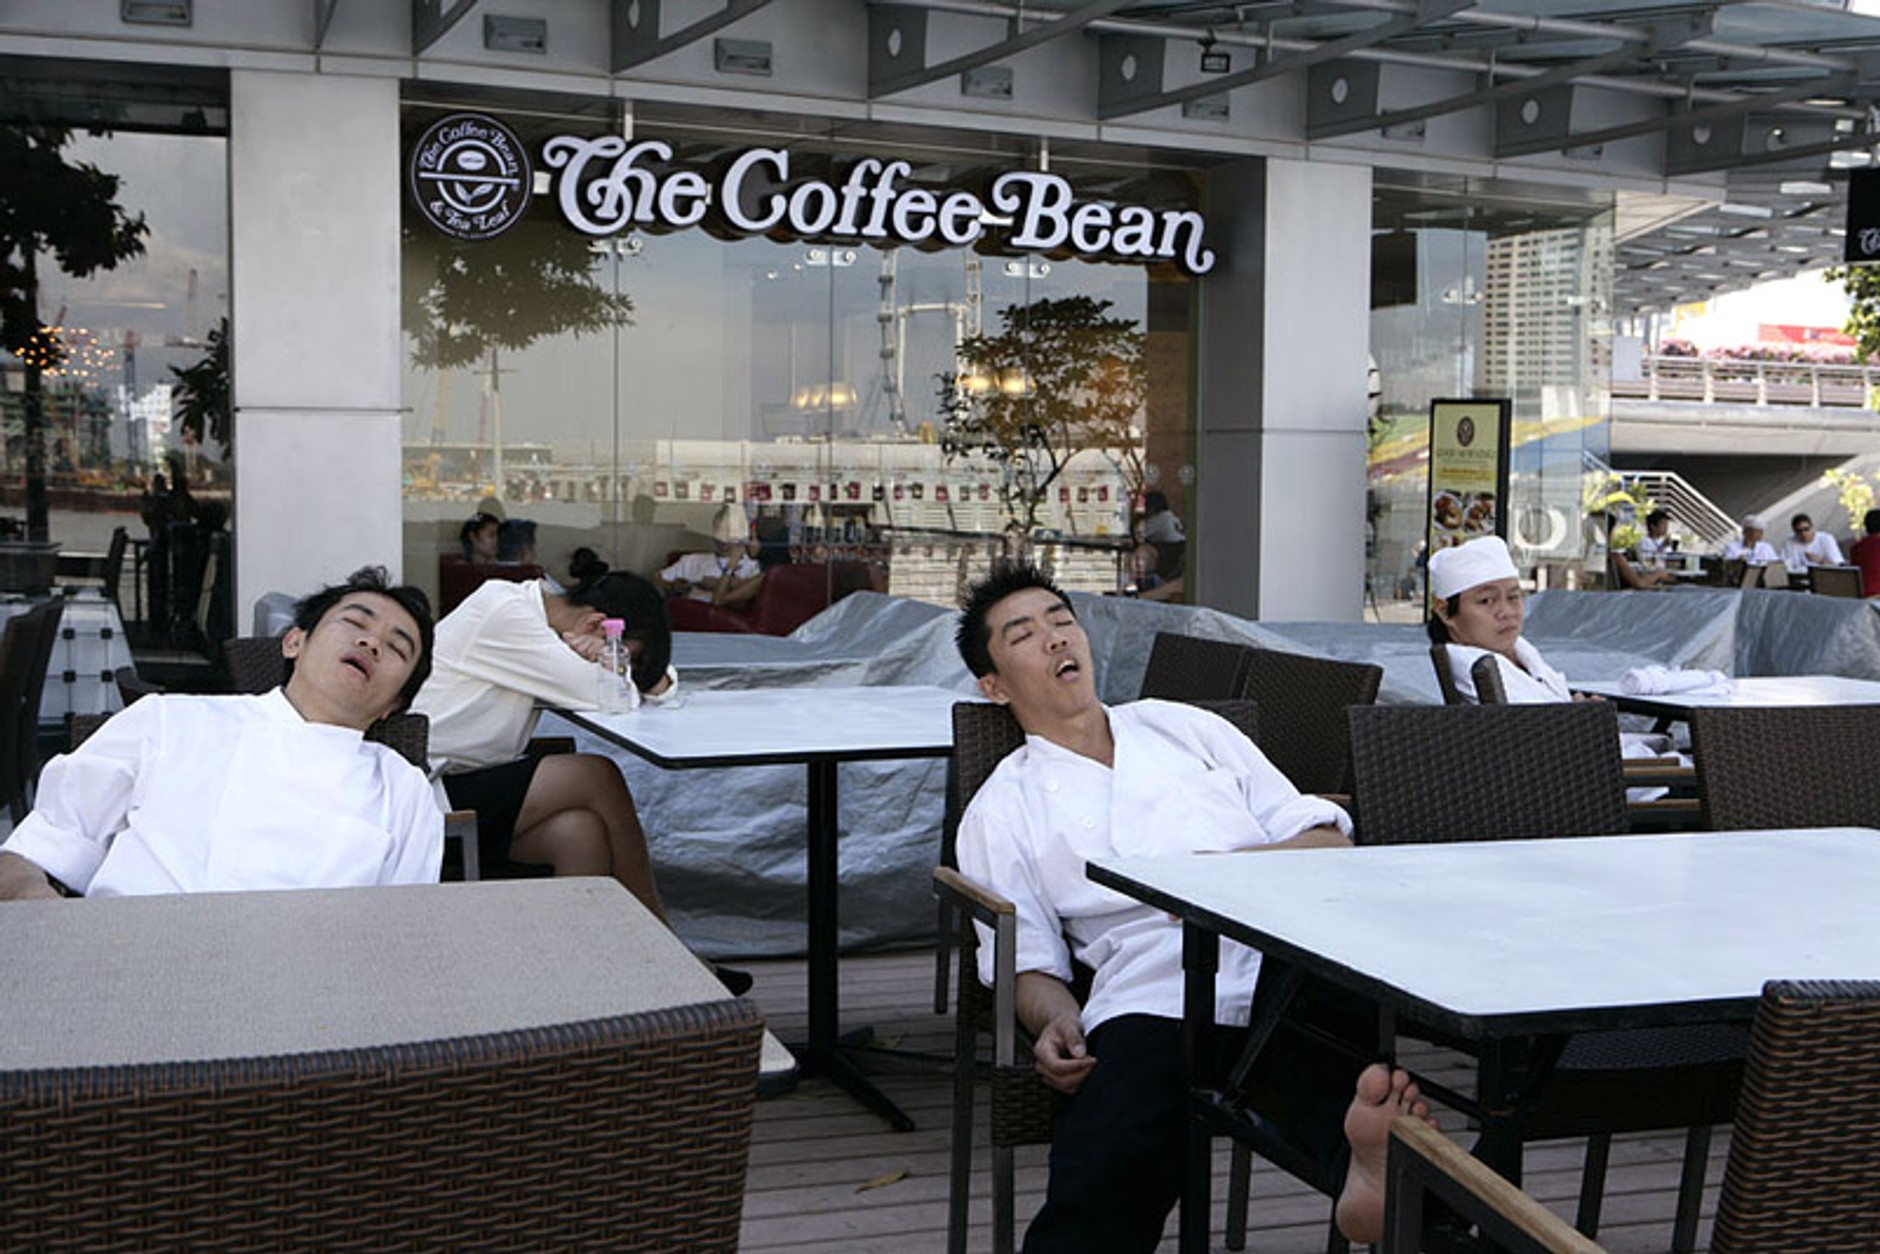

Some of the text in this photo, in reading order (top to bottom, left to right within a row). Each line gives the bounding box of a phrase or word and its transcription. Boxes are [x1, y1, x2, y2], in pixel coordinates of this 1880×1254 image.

[420, 121, 518, 176] The Coffee Bean
[446, 210, 471, 231] Tea
[473, 199, 511, 231] Leaf
[542, 135, 1214, 273] The Coffee Bean
